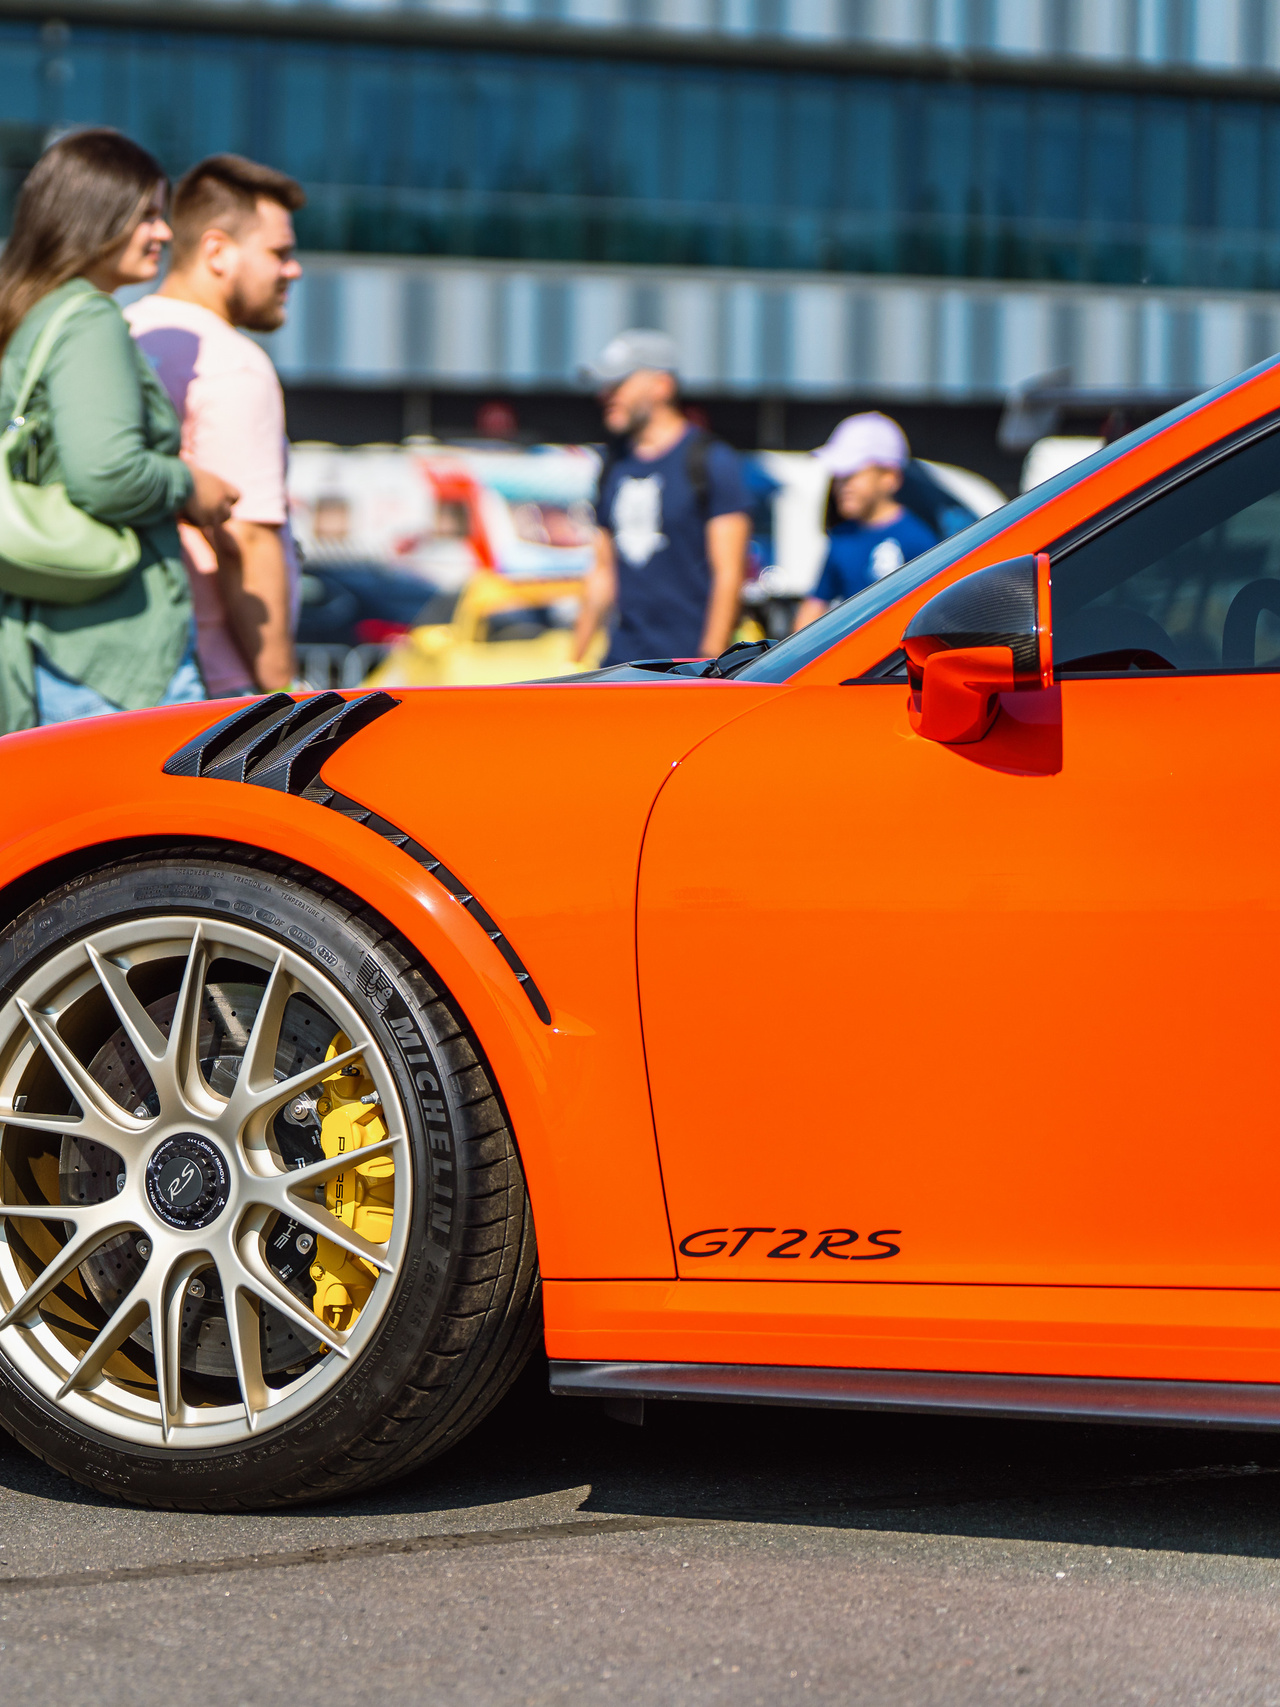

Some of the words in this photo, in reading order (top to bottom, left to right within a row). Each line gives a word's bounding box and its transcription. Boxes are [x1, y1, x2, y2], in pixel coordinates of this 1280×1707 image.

[232, 874, 261, 889] TRACTION
[263, 884, 272, 893] AA
[280, 891, 319, 918] TEMPERATURE
[319, 915, 326, 923] A
[389, 1016, 456, 1234] MICHELIN
[167, 1162, 195, 1202] RS
[408, 1260, 439, 1328] 265/35
